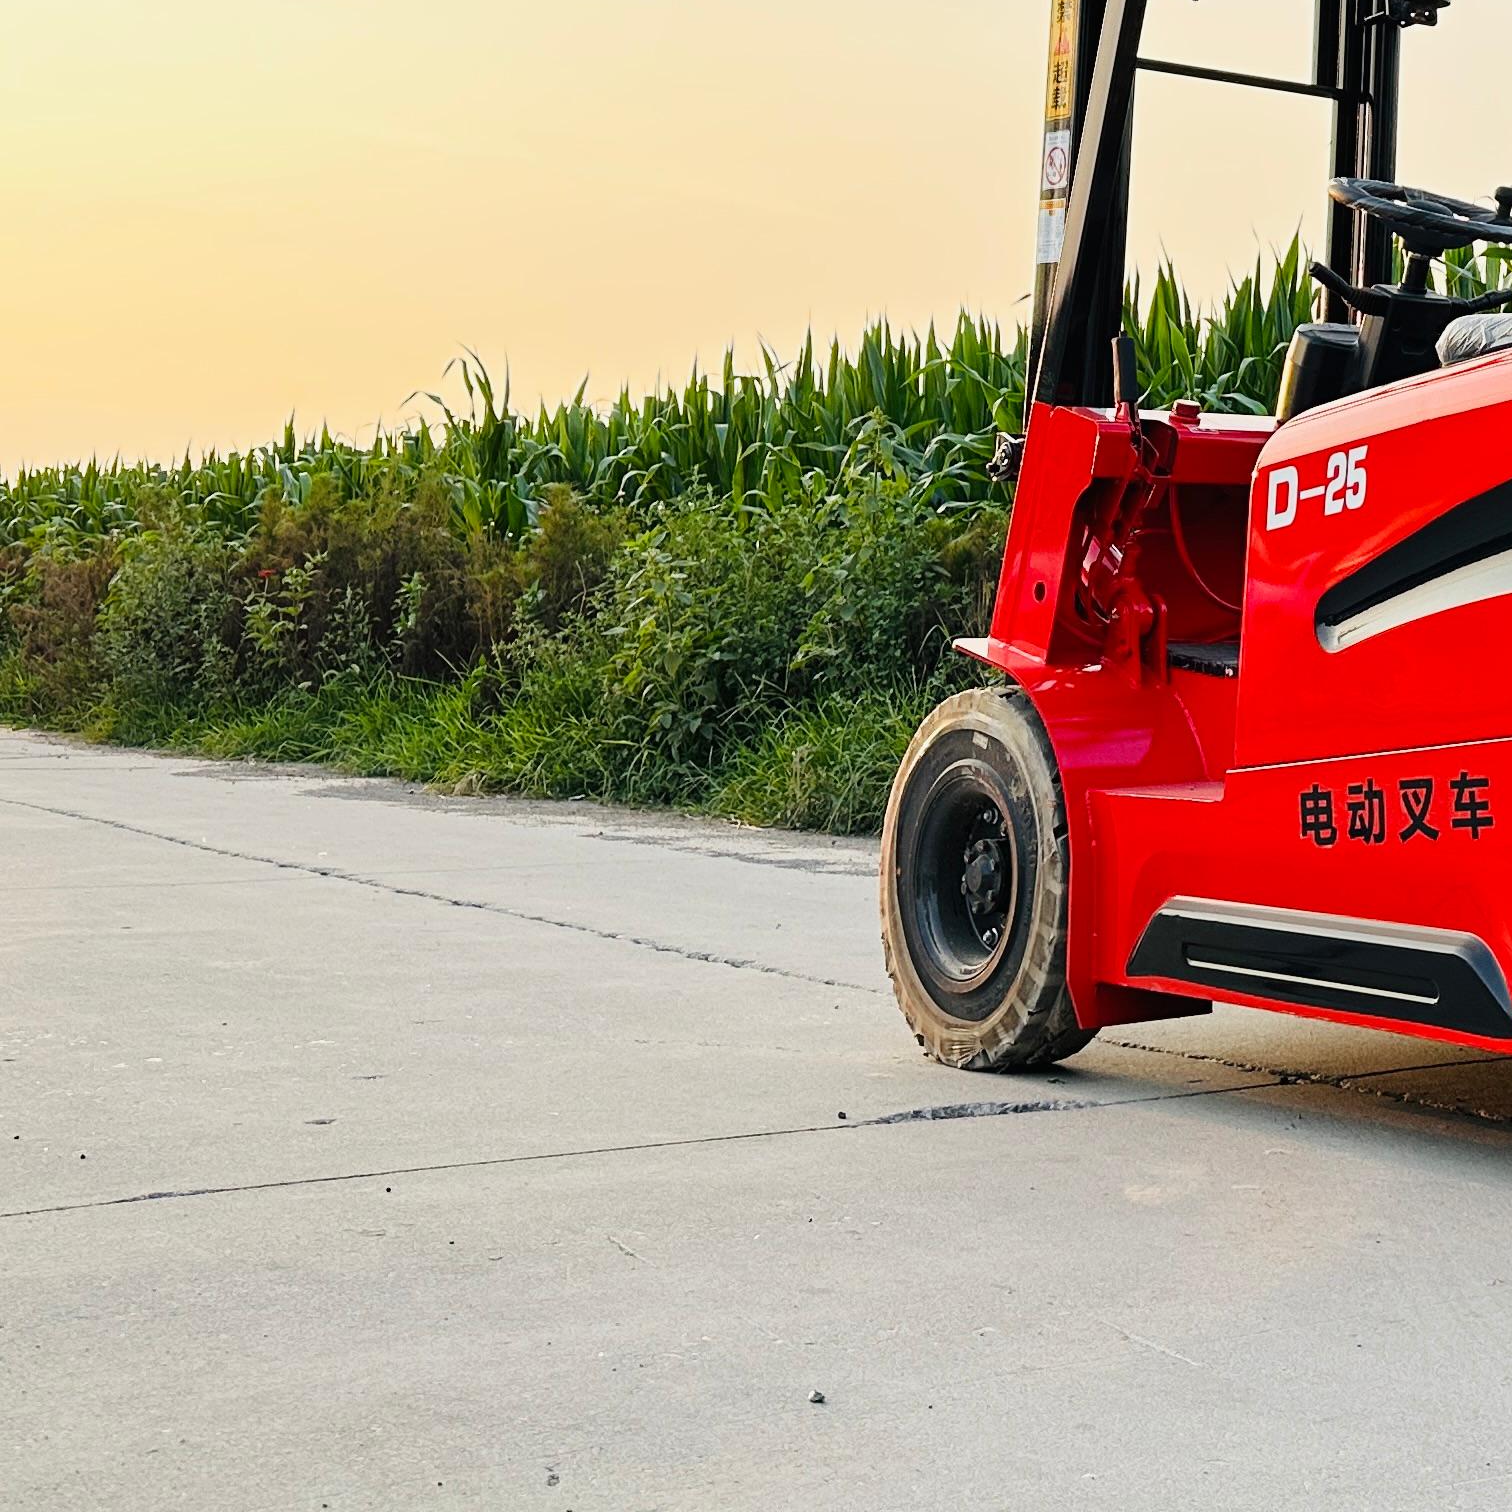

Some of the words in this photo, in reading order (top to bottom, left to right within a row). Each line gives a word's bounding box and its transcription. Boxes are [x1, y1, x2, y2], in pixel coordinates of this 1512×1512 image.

[1266, 445, 1368, 531] D-25
[1299, 770, 1494, 847] 电动叉车
